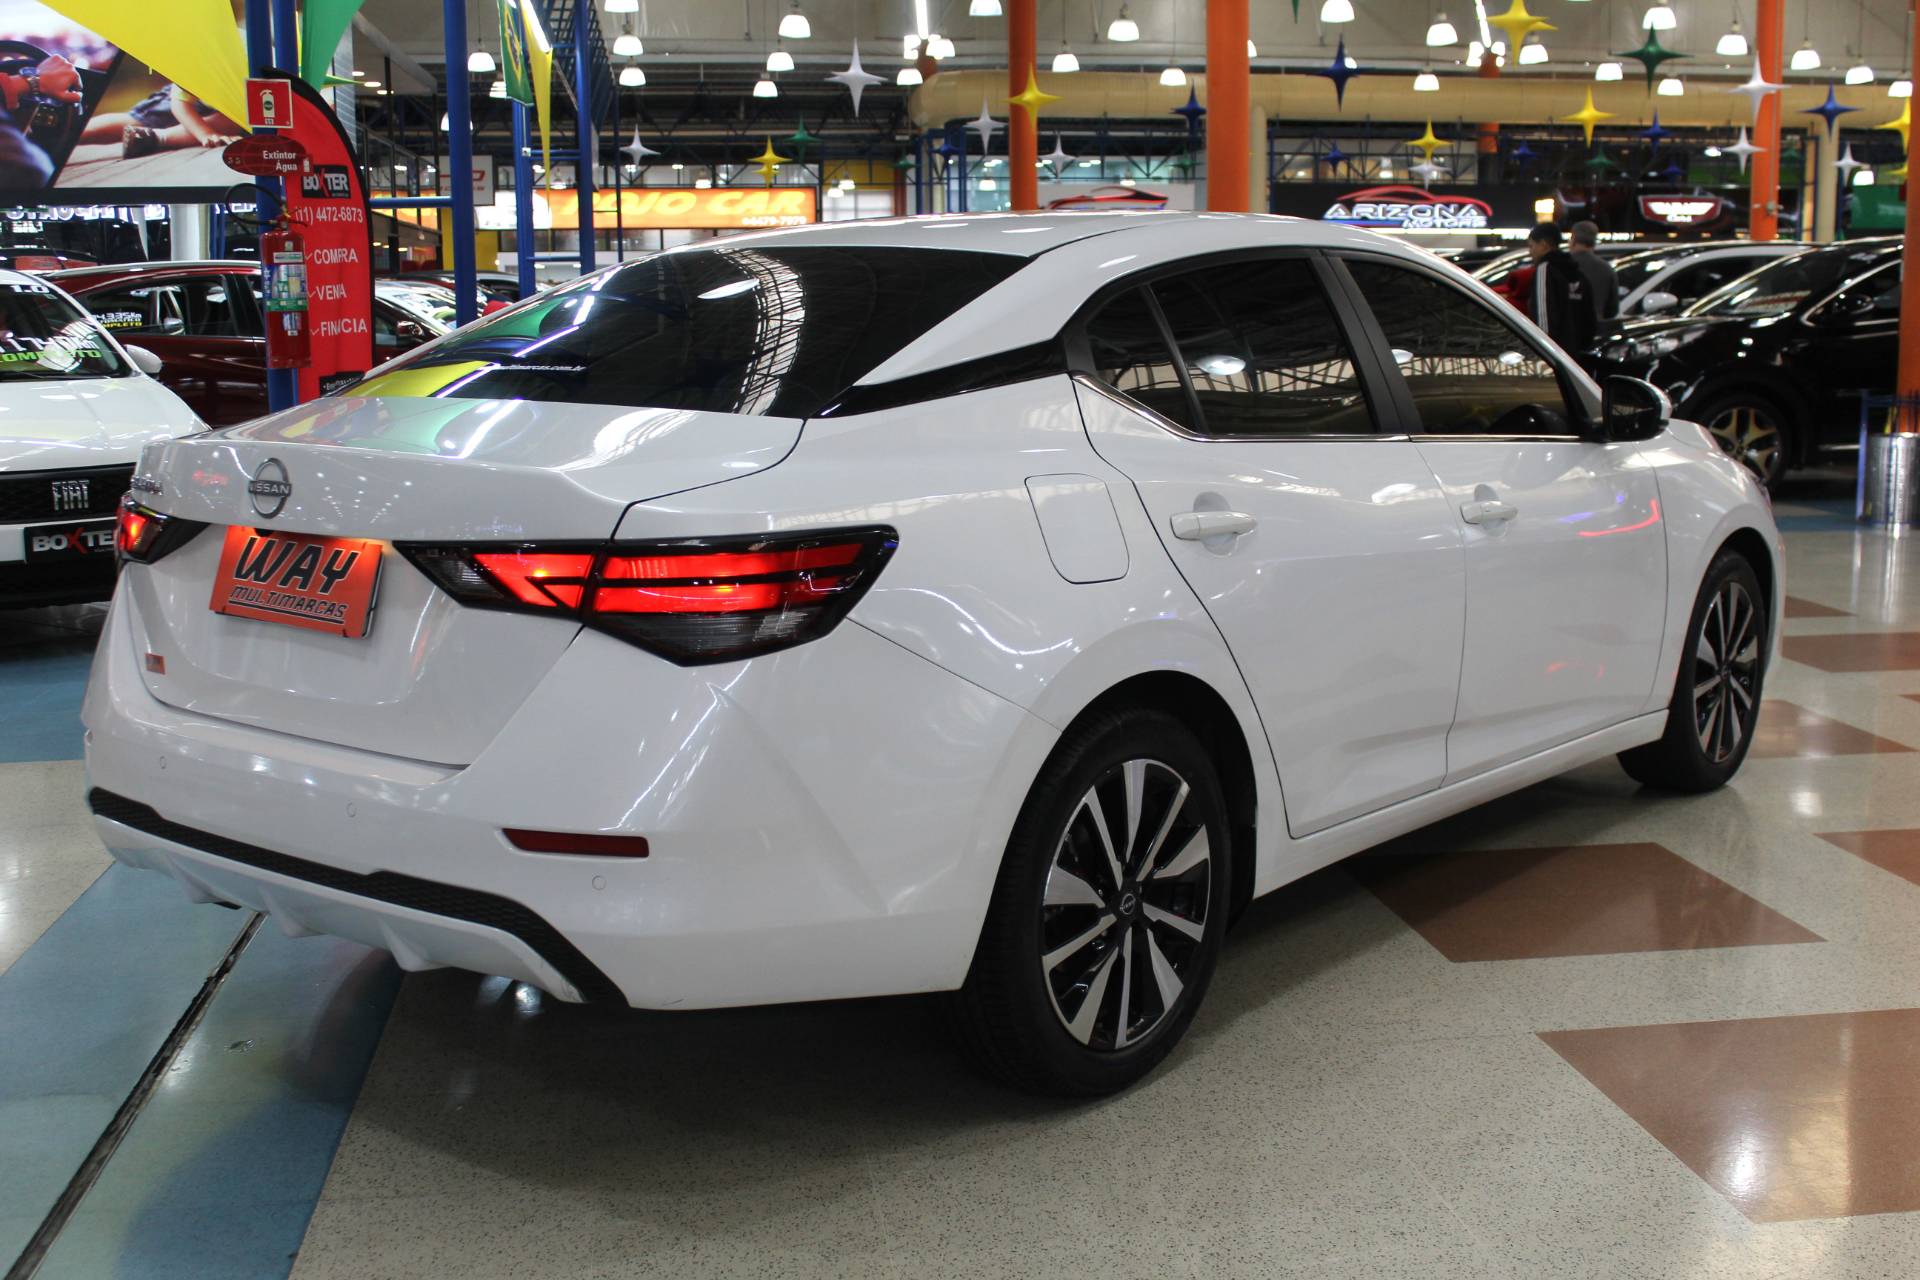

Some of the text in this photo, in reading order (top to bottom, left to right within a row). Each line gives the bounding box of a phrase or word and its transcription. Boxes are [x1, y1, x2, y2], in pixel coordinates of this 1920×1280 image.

[262, 150, 297, 160] Extintor
[275, 160, 298, 172] Água
[303, 170, 349, 195] BOXTER
[706, 190, 806, 215] CAR
[1323, 203, 1485, 220] ARIZONA
[295, 206, 363, 226] (11) 4472-6873
[1402, 216, 1488, 228] MOTORS
[313, 248, 359, 264] COMPRA
[52, 480, 89, 510] FIAT
[32, 528, 115, 554] BOXTE
[233, 535, 361, 596] WAY
[229, 585, 348, 618] MULTIMARCAS
